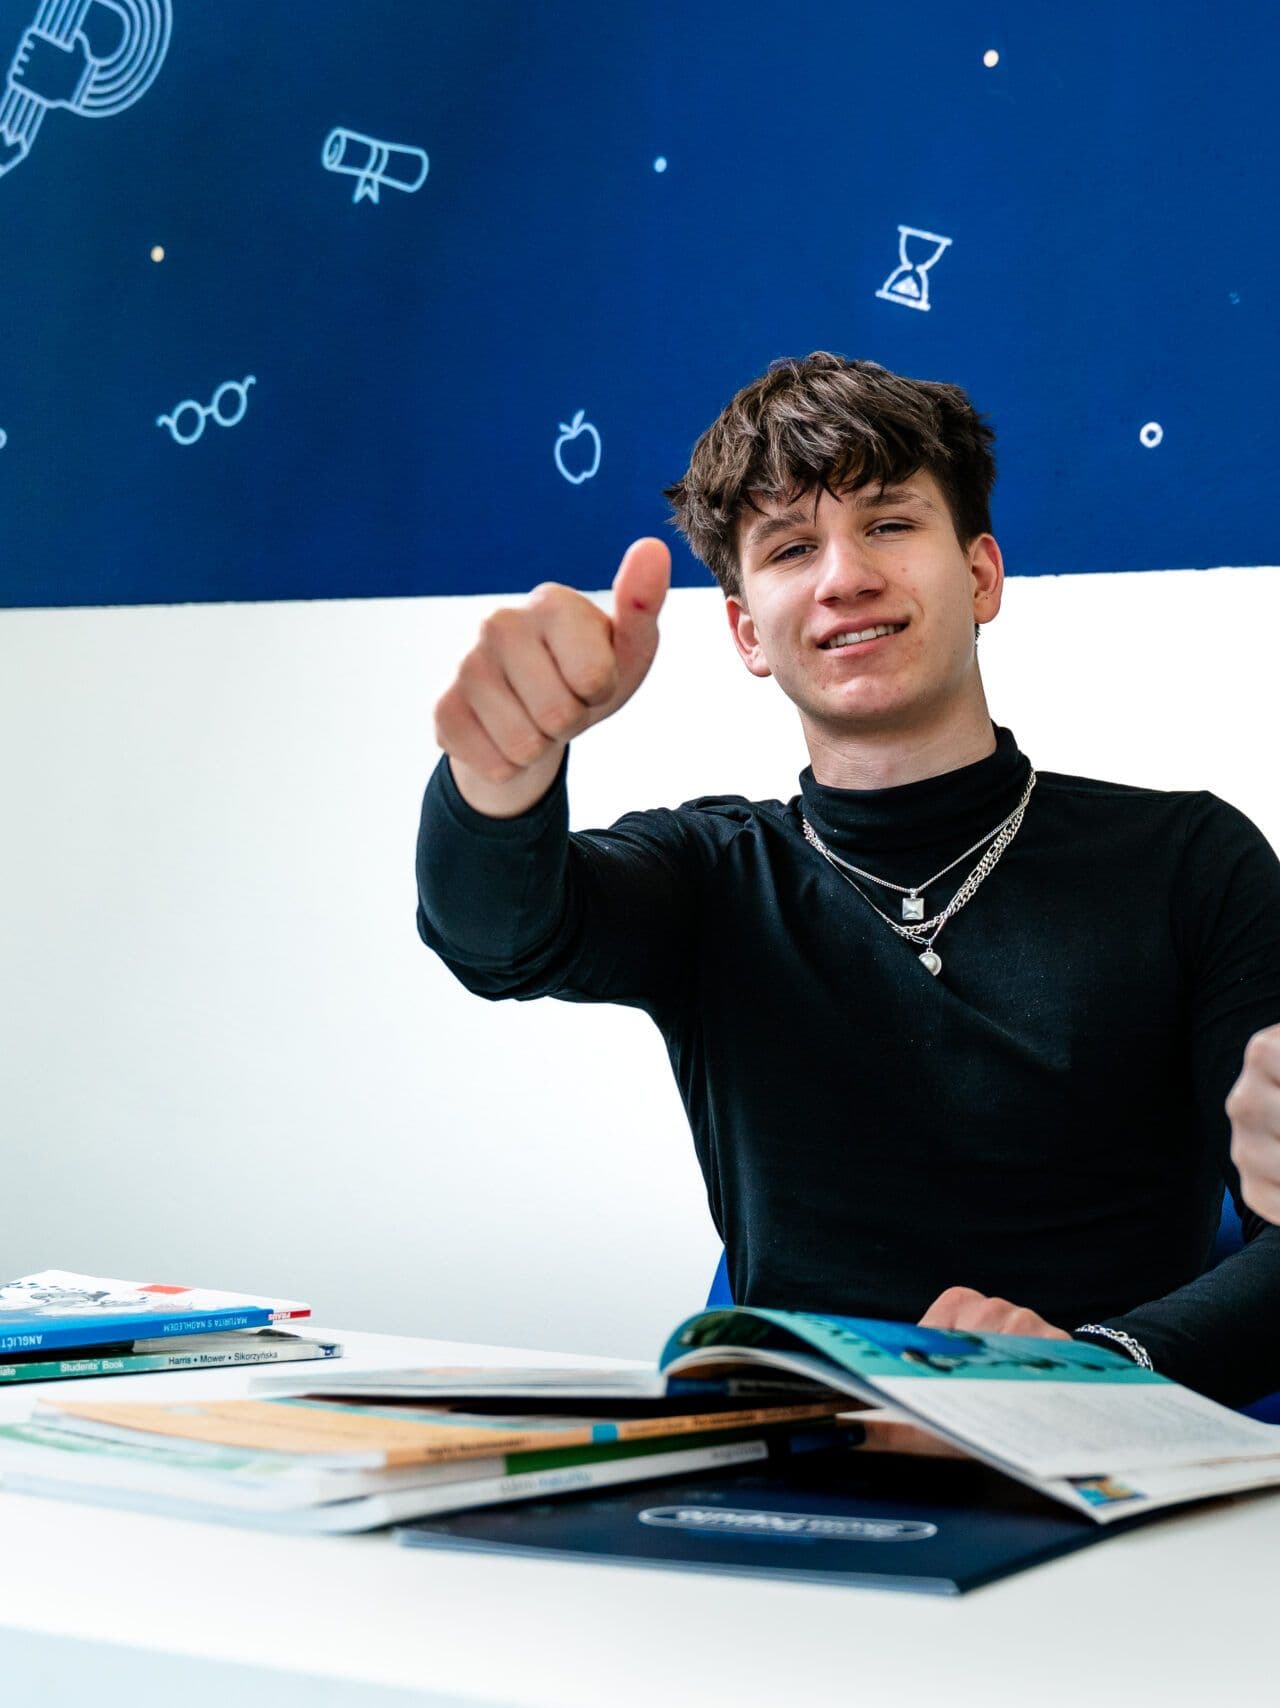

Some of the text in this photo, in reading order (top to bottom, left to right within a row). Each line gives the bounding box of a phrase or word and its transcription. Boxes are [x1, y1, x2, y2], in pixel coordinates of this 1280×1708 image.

[163, 1320, 206, 1332] NADHLEDEM
[214, 1316, 248, 1327] MATURITA
[102, 1359, 124, 1370] Book
[168, 1356, 191, 1365] Harris
[200, 1354, 226, 1363] Mower
